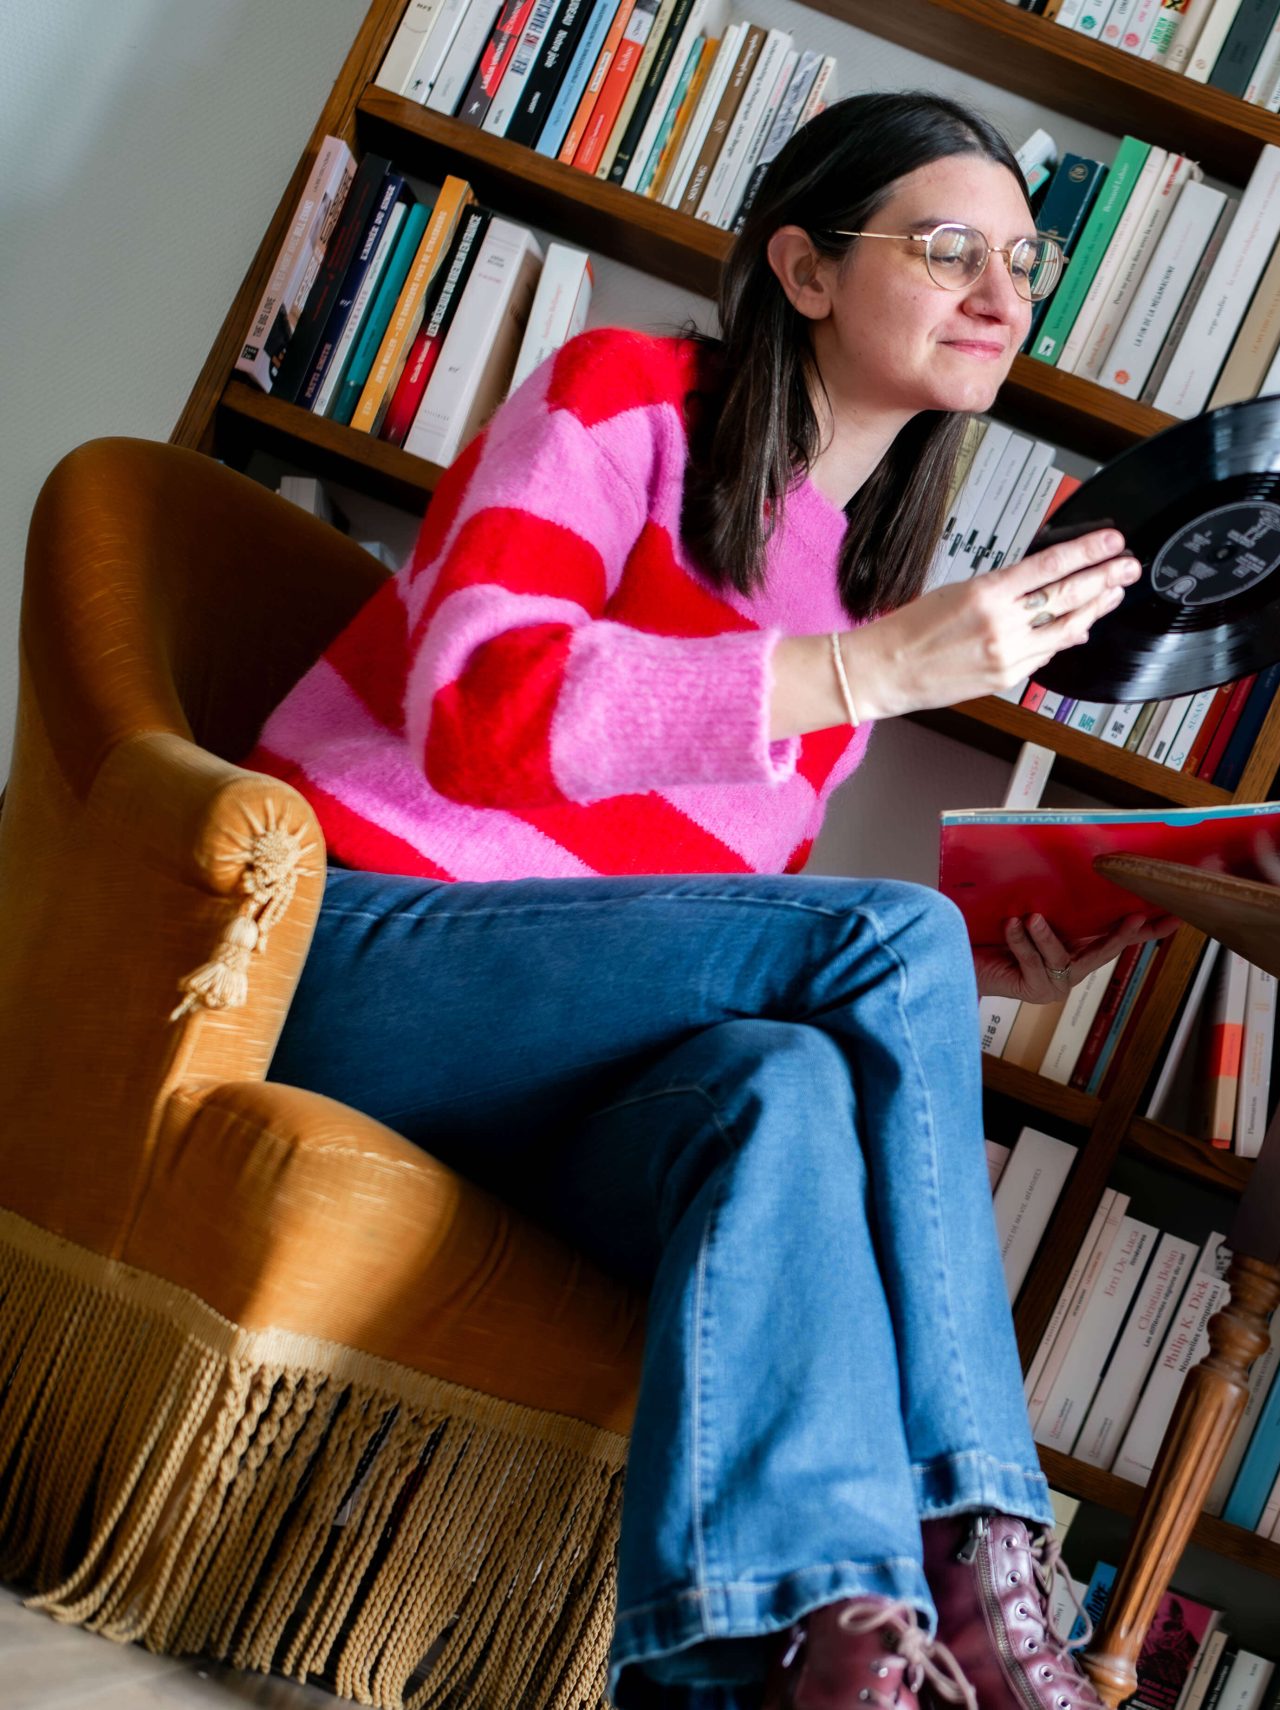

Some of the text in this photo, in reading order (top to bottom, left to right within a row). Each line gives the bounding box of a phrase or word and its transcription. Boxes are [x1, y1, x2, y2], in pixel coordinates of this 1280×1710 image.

[542, 26, 567, 68] Notre joie
[686, 163, 708, 202] SONTAG
[1103, 184, 1120, 213] Bernard
[358, 182, 396, 261] L'ANNÉE DU SINGE
[425, 212, 482, 338] LES RÉSEAUX DU KREMLIN EN FRANCE
[253, 295, 275, 338] THE BIG LOVE
[1134, 264, 1176, 347] LA FIN DE LA MÉGAMACHINE
[304, 341, 332, 398] PATTI SMITH
[1187, 700, 1205, 730] SUSAN
[986, 1014, 1001, 1036] 10 18
[1113, 1255, 1129, 1275] De
[1121, 1228, 1141, 1256] Luca
[1136, 1246, 1181, 1332] Christian Bobin
[1142, 1251, 1187, 1347] Les différentes régions du ciel
[1163, 1277, 1210, 1371] Philip K. Dick
[1177, 1331, 1201, 1372] Nouvelles
[1195, 1288, 1220, 1332] complètes
